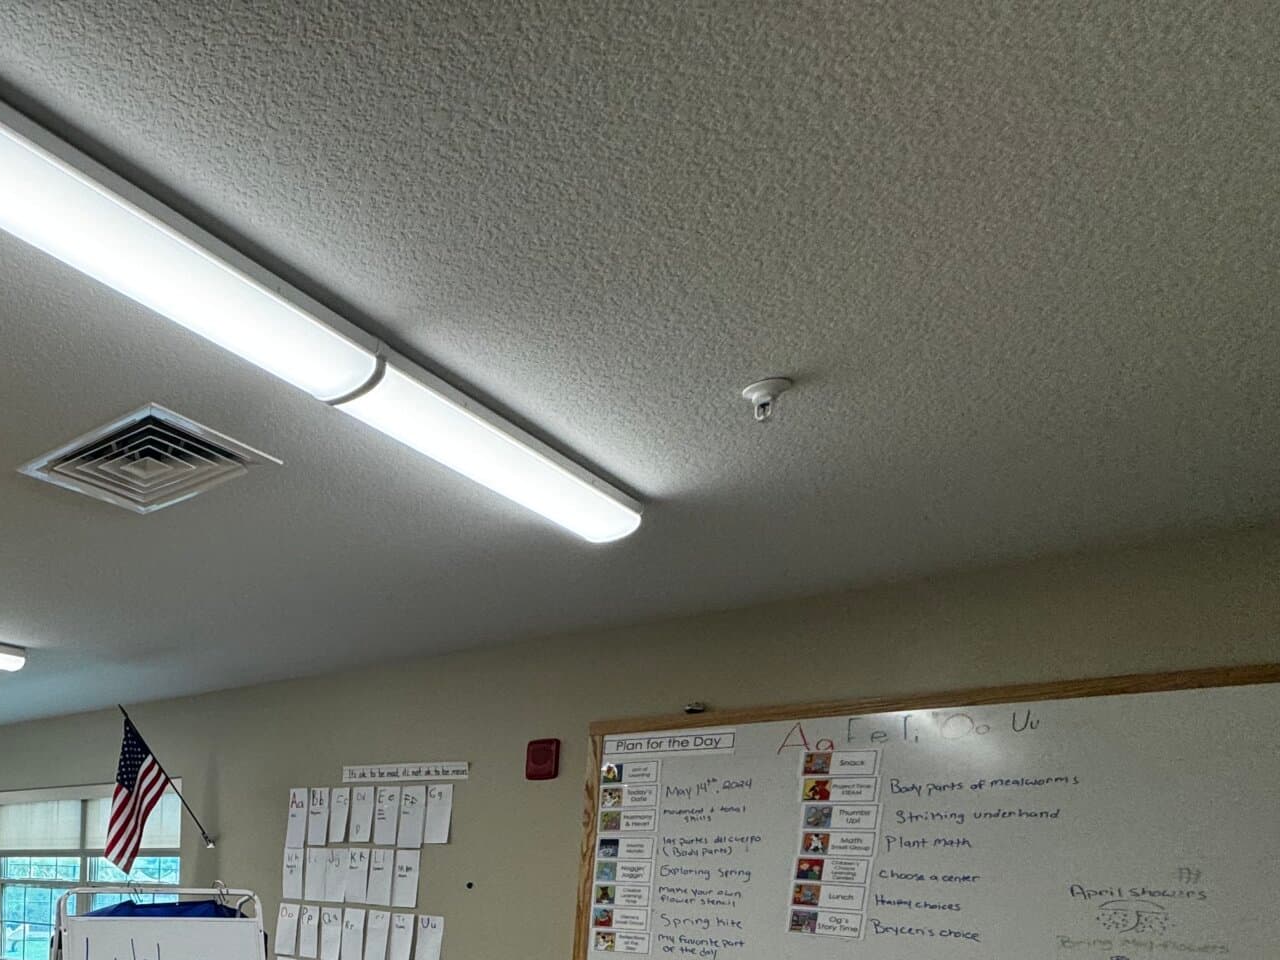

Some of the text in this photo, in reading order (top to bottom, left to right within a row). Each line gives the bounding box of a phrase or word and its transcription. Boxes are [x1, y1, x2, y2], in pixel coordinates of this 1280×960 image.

[1012, 709, 1040, 733] Uu
[616, 735, 723, 752] Plan for the Day
[665, 785, 692, 800] May
[722, 777, 752, 790] 2024
[889, 778, 921, 796] Body
[928, 782, 964, 796] parts
[970, 781, 985, 792] of
[290, 791, 305, 809] Aa
[885, 835, 929, 852] Plant
[929, 874, 938, 883] a
[828, 893, 855, 901] Lunch
[1069, 883, 1124, 900] April
[420, 916, 437, 929] Uu
[659, 913, 711, 930] Spring
[680, 946, 697, 955] the
[721, 938, 745, 949] part
